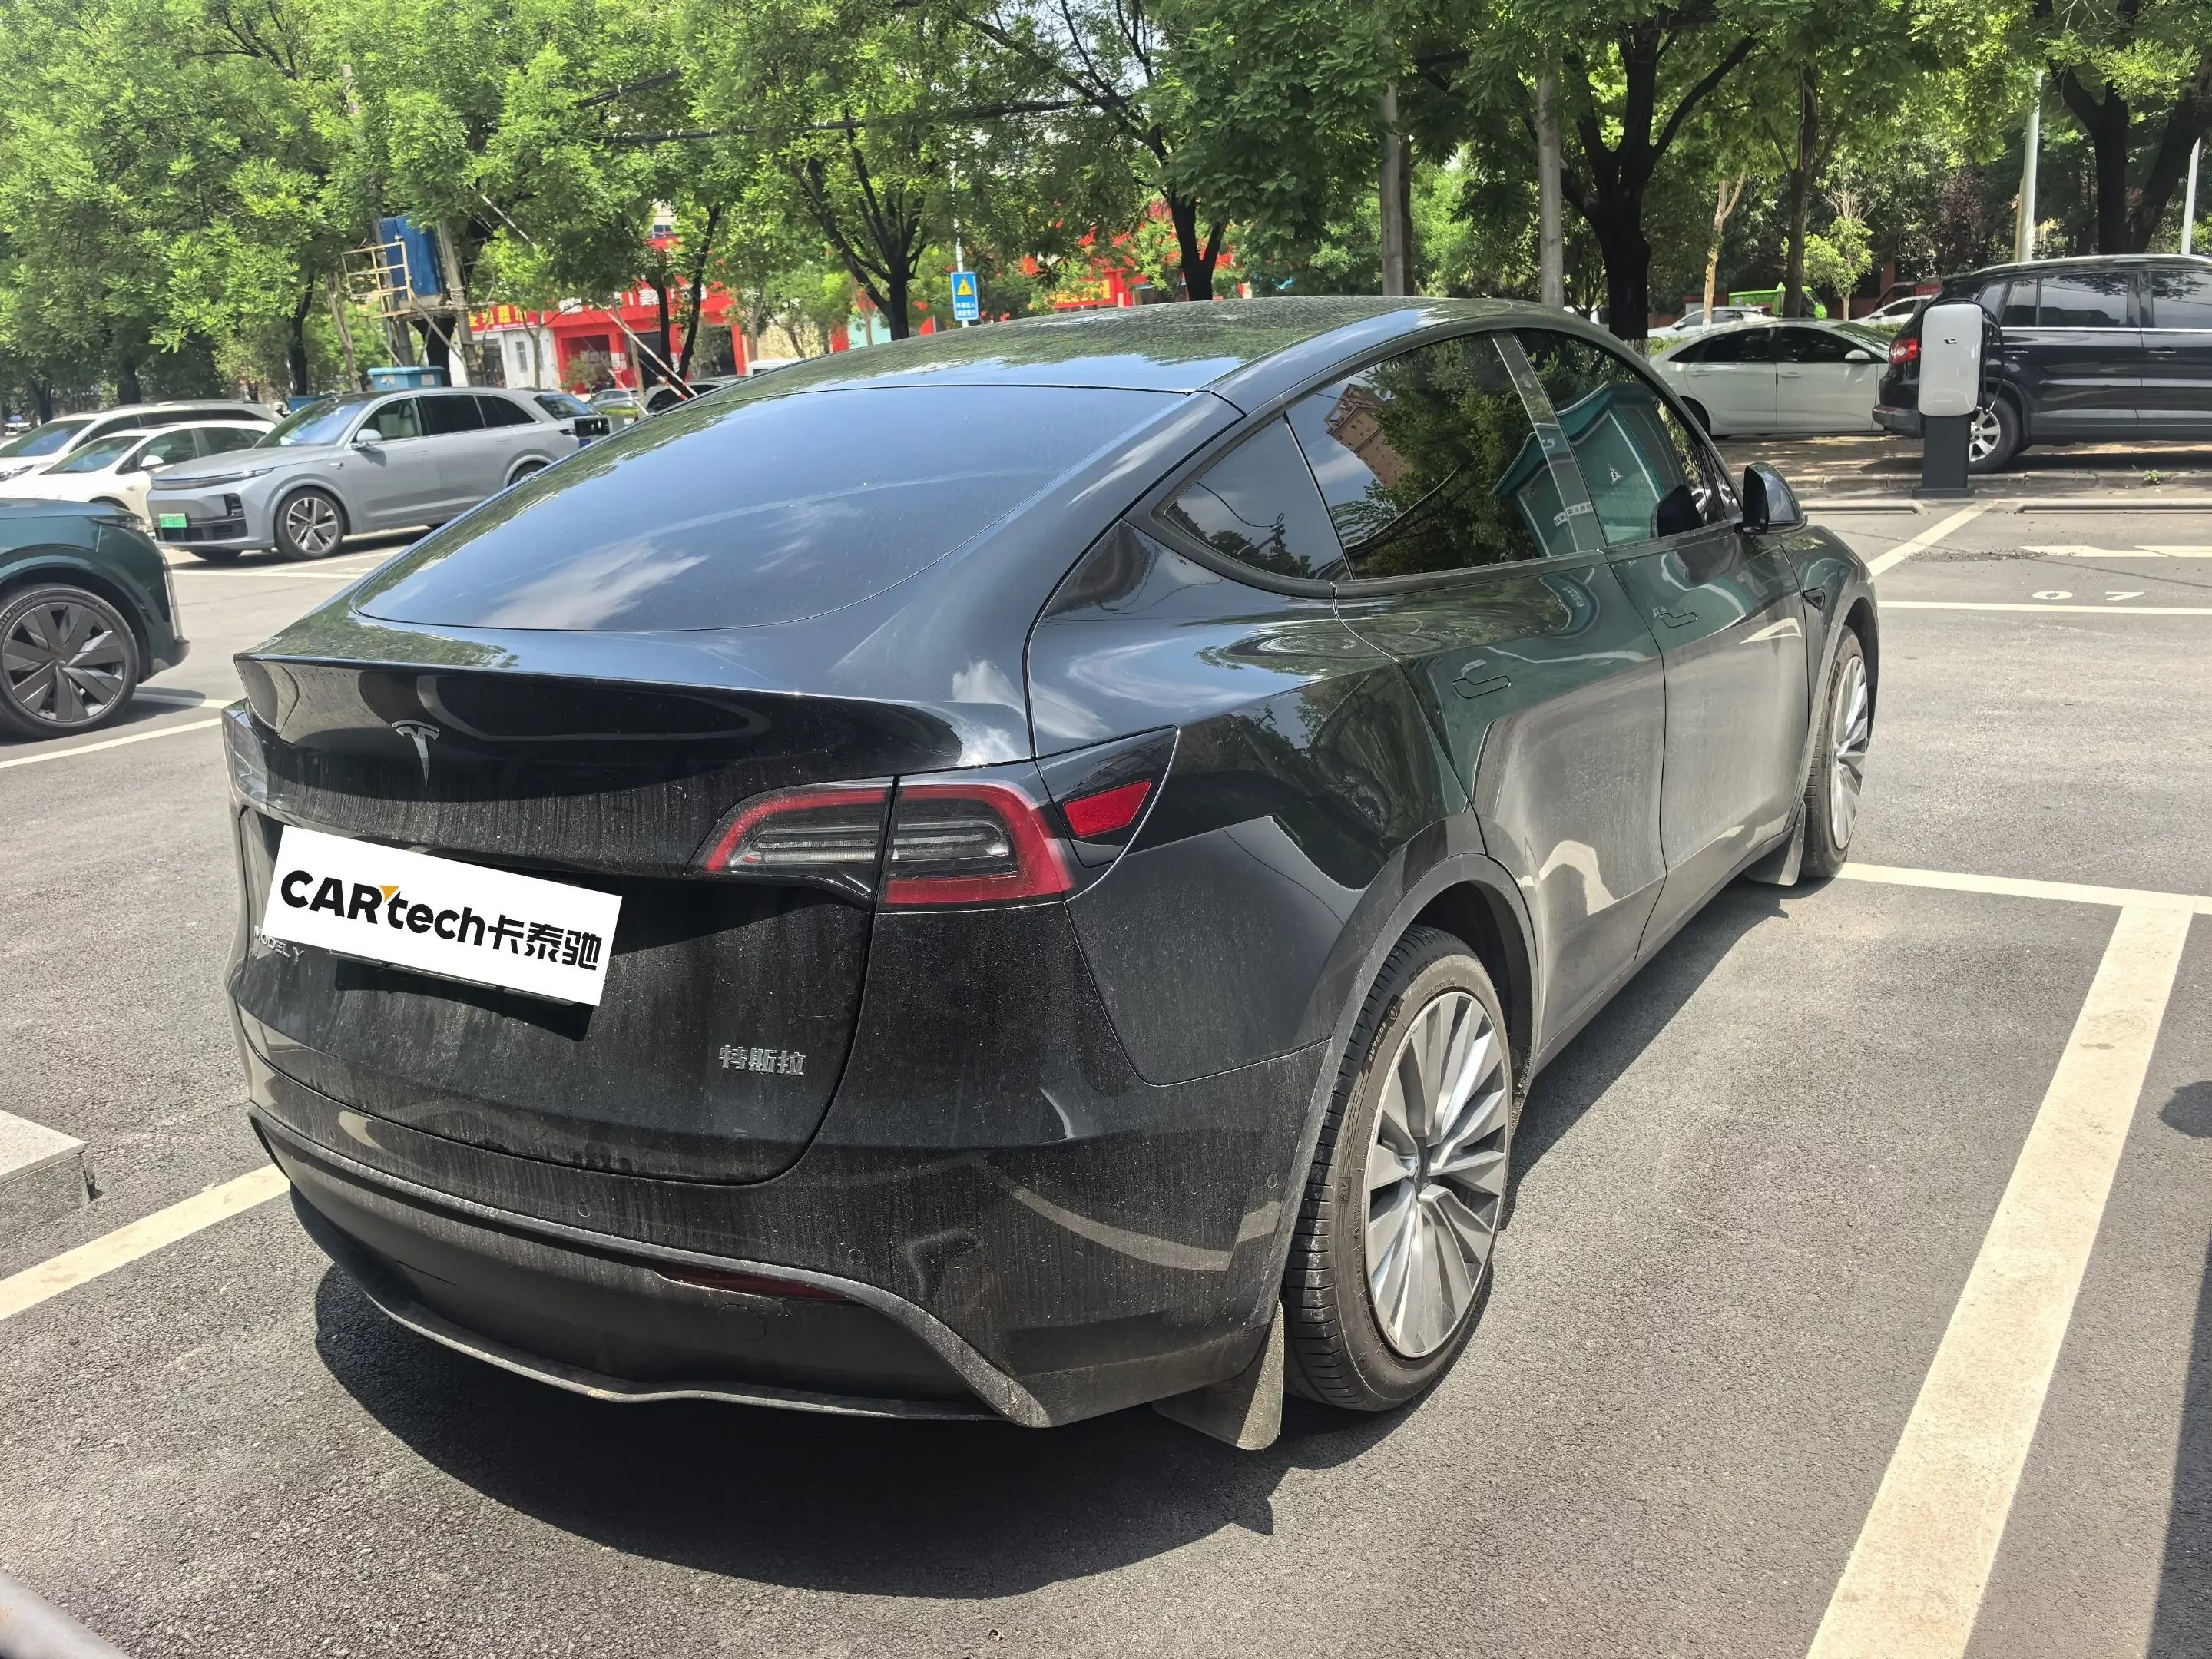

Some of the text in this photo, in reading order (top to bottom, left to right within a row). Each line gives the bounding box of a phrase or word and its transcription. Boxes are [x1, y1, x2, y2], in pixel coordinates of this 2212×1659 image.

[253, 924, 305, 962] MODEL Y
[1368, 1021, 1387, 1061] OUTSIDE
[718, 1045, 806, 1076] 特斯拉
